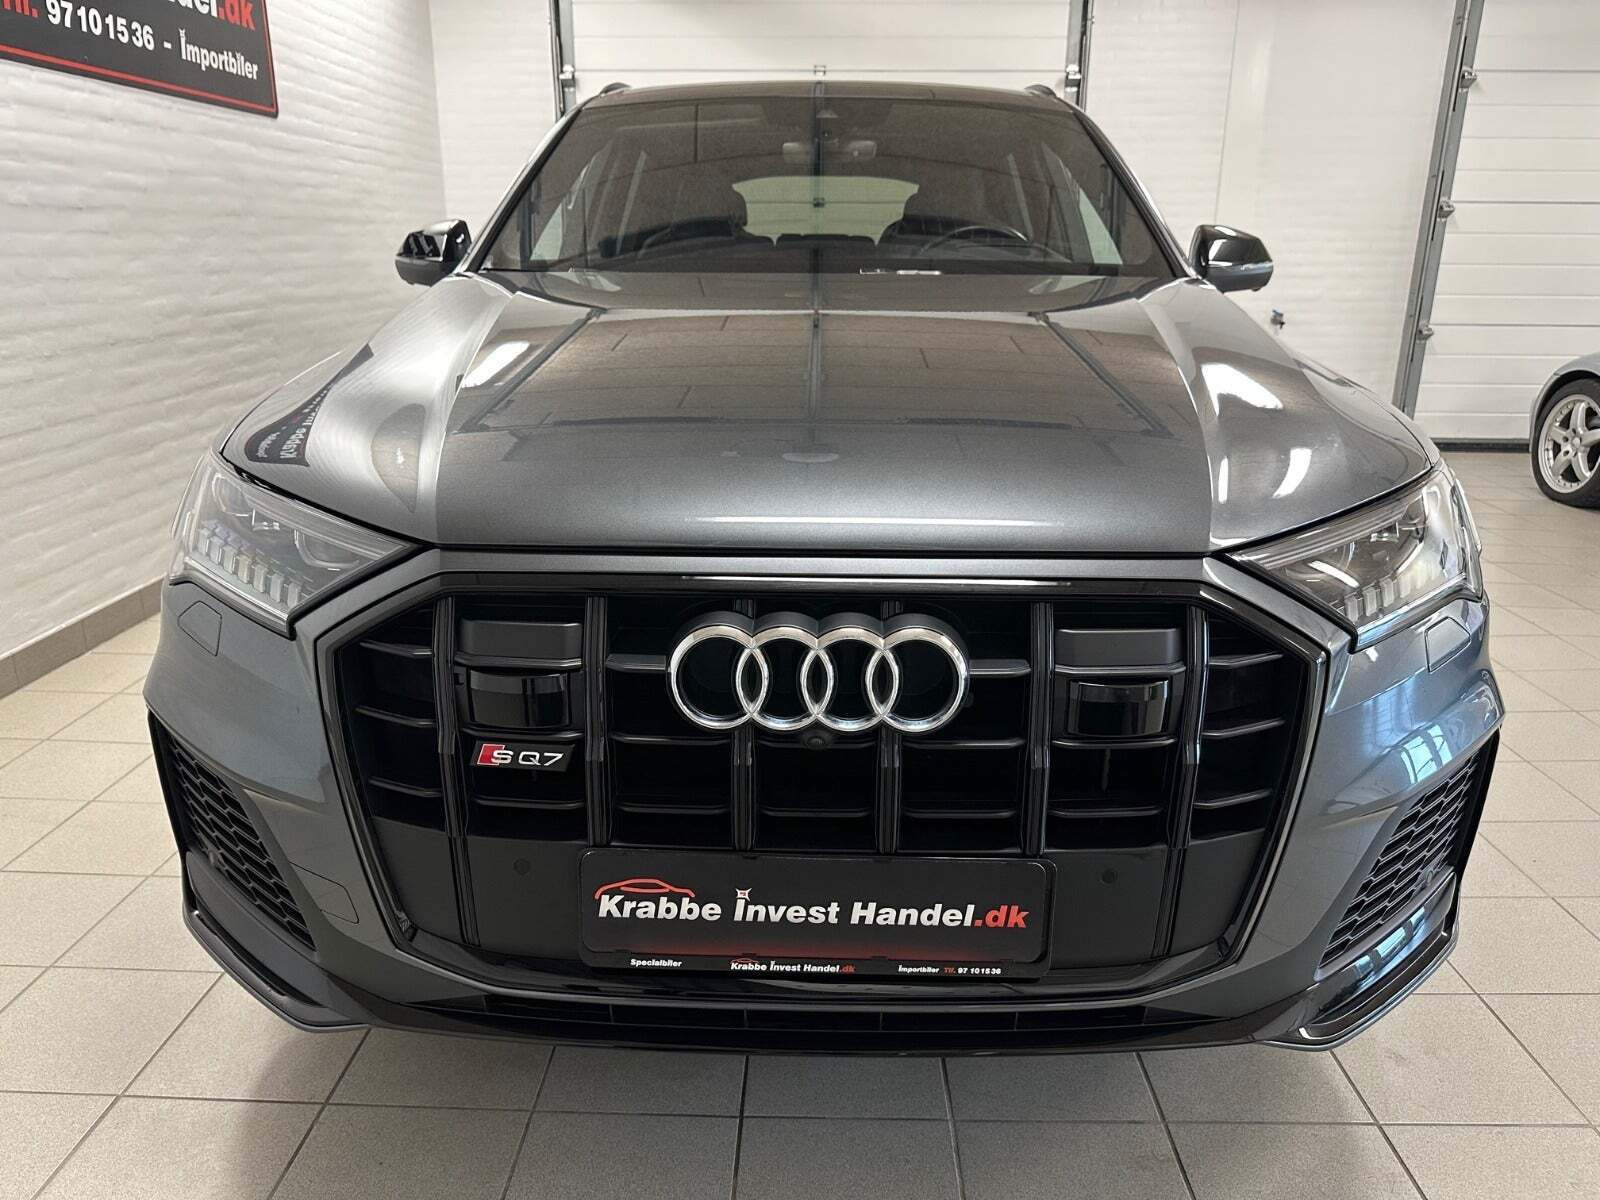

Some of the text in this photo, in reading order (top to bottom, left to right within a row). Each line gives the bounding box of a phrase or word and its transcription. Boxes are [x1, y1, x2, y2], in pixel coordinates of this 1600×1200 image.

[598, 889, 1029, 928] Krabbe Invest Handel.dk
[630, 958, 683, 968] Specialbiler
[730, 961, 768, 972] Krabbe
[803, 963, 856, 974] Handel.dk
